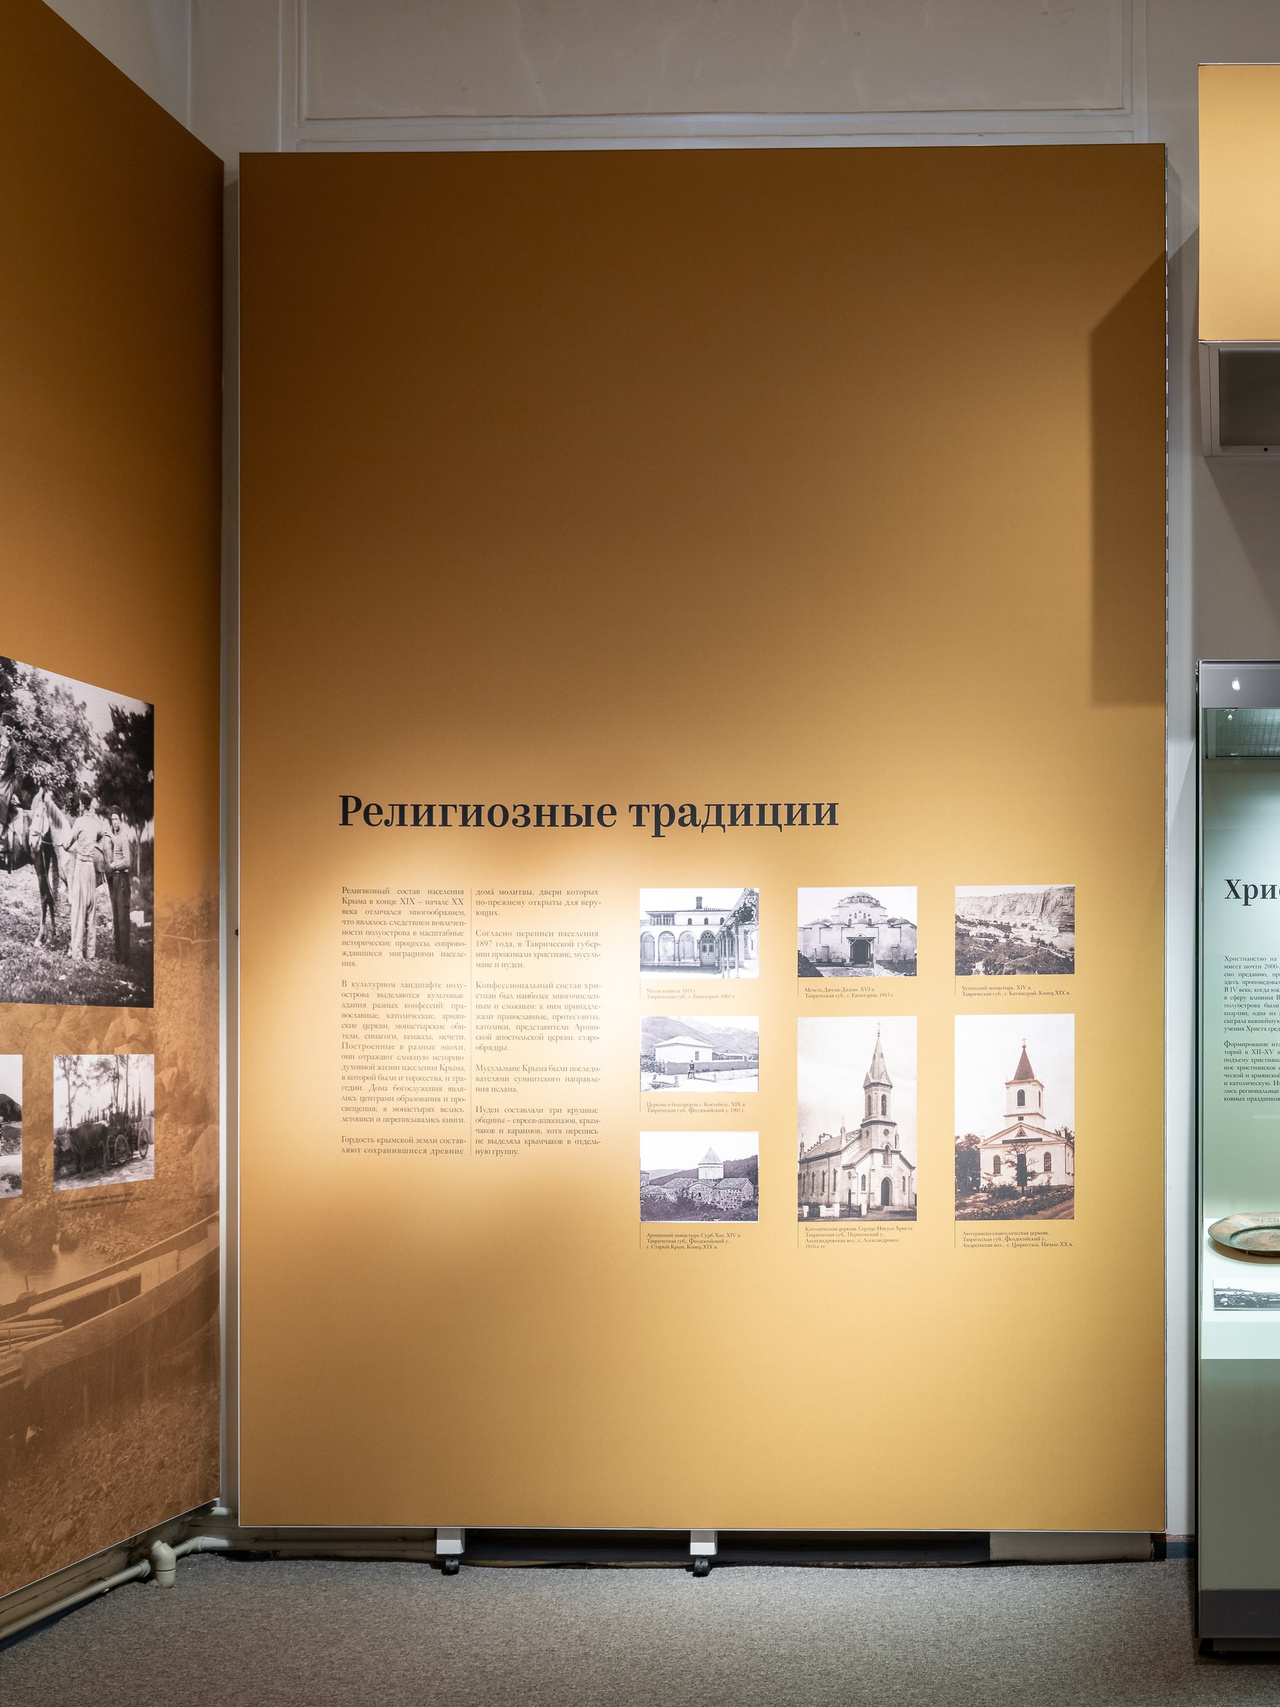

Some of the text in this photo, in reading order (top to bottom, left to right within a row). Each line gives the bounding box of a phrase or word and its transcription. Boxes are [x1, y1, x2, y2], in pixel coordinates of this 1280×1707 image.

[338, 794, 839, 838] Религиозные традиции
[342, 897, 367, 907] Крыма
[399, 897, 415, 905] XIX
[419, 929, 464, 937] масштабные
[389, 951, 434, 959] миграциями
[341, 1135, 376, 1145] Гордость
[376, 1135, 414, 1146] крымской
[430, 1148, 464, 1156] древние
